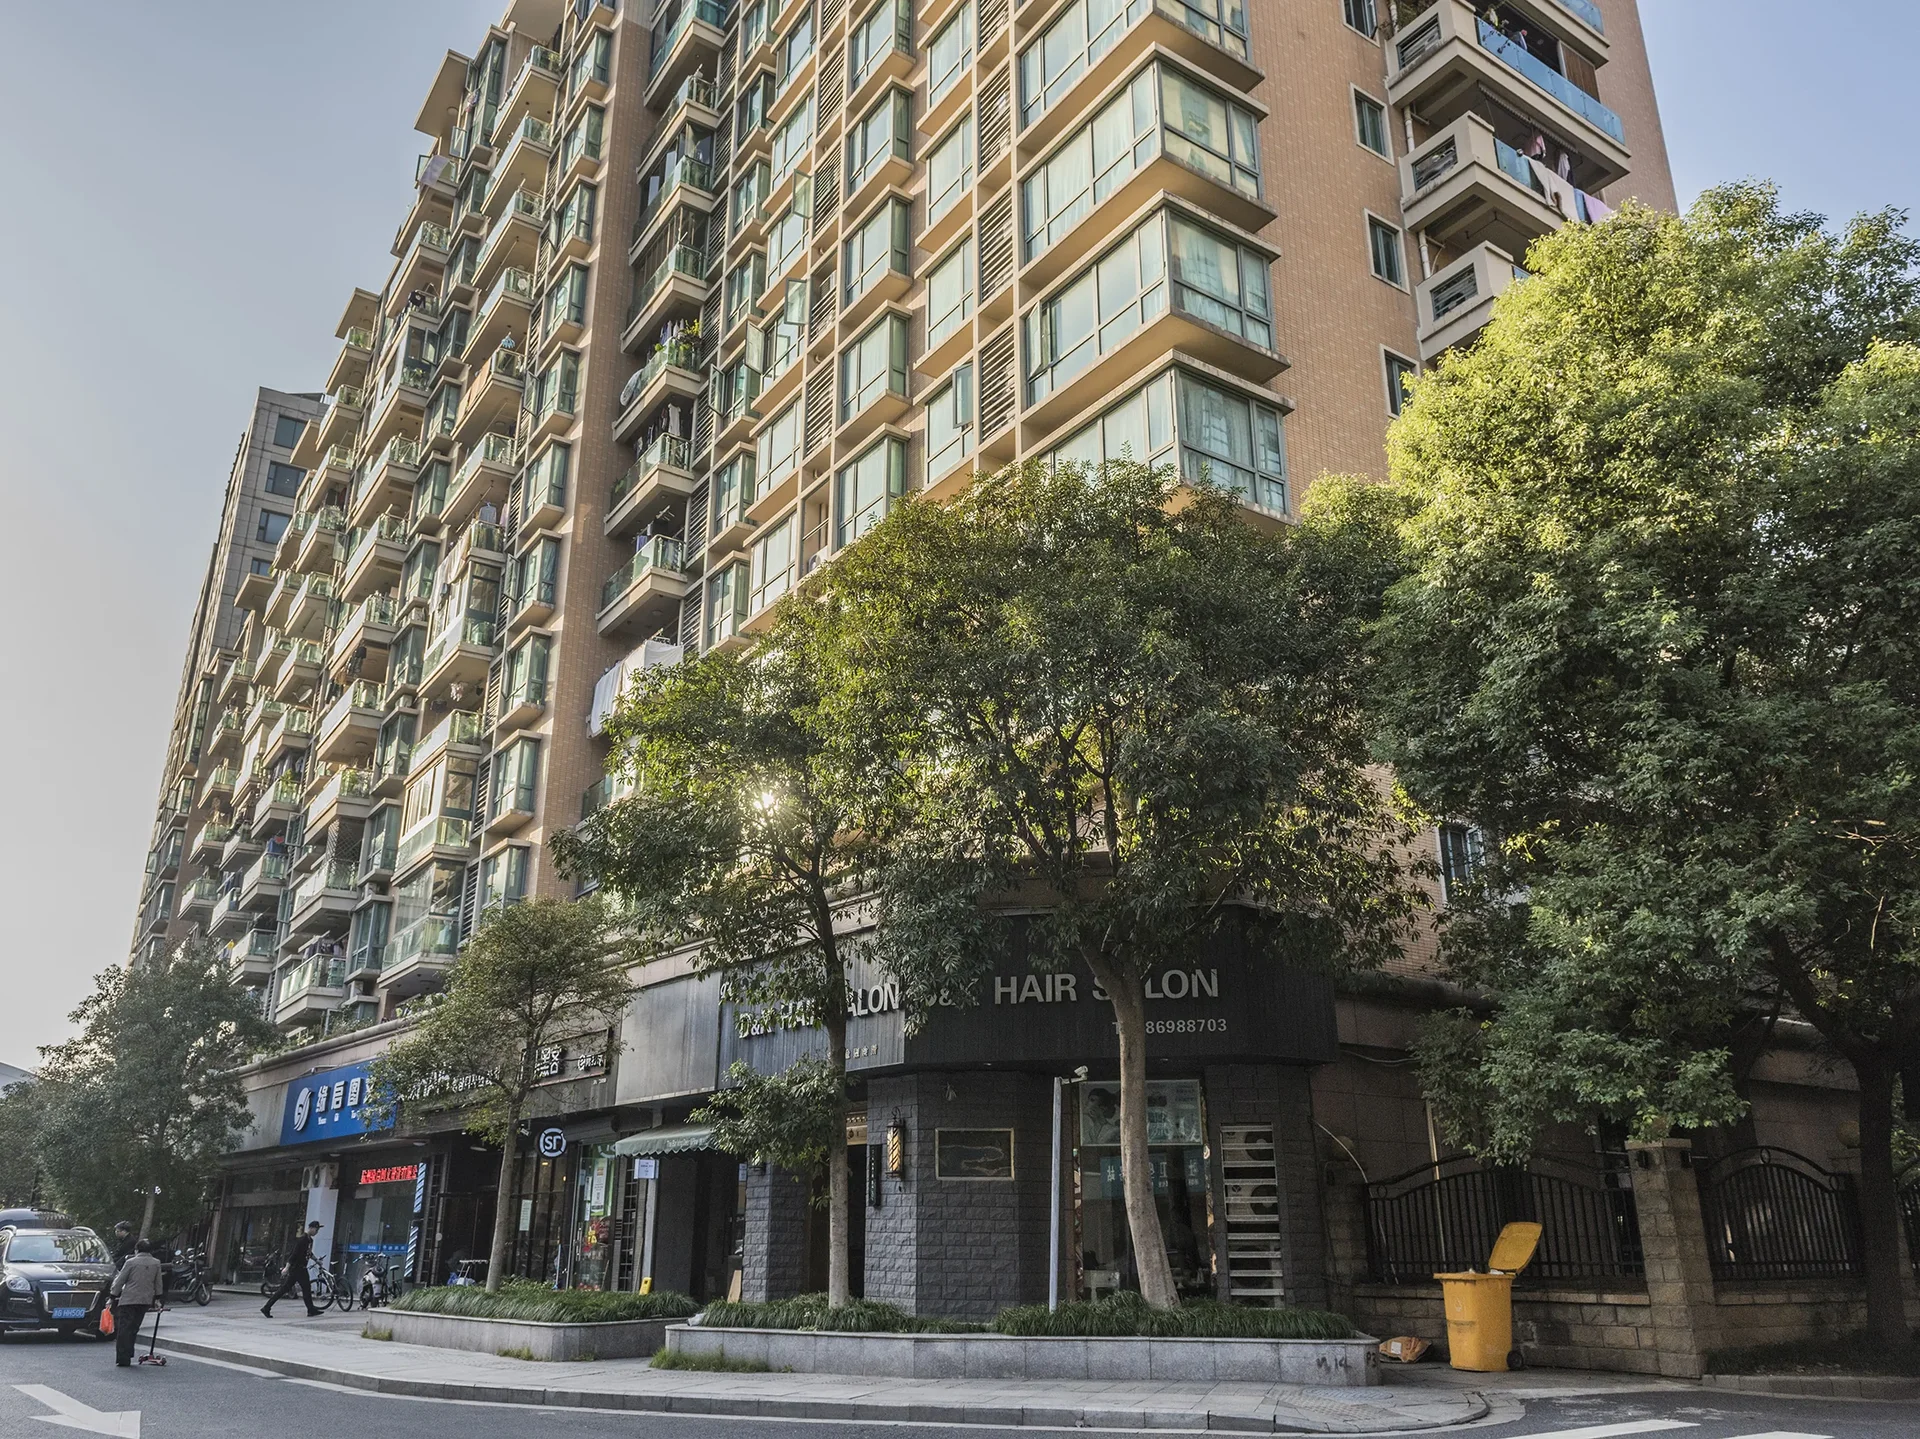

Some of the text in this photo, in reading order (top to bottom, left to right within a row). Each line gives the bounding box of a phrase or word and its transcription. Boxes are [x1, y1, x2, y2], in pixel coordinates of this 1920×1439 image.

[843, 982, 900, 1018] ALON
[995, 973, 1078, 1005] HAIR
[1092, 968, 1219, 1001] SLON
[1145, 1019, 1228, 1034] 86988703
